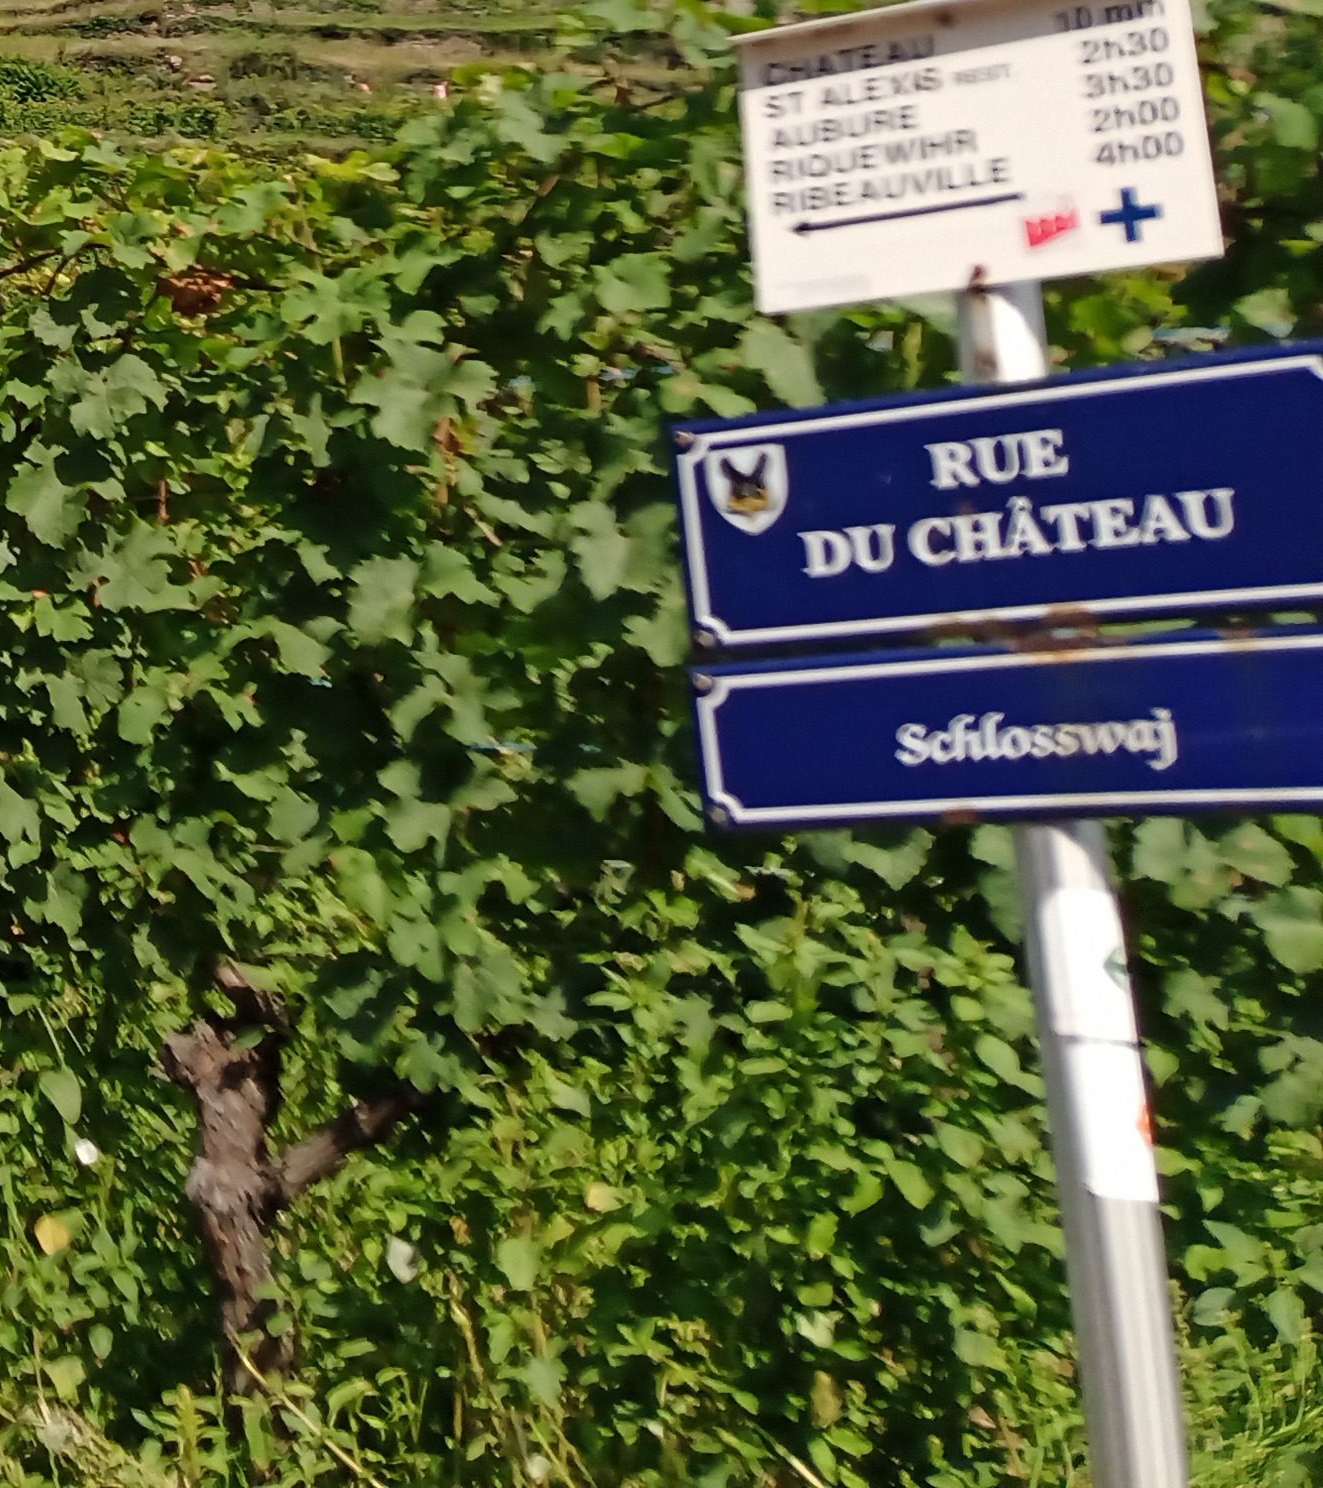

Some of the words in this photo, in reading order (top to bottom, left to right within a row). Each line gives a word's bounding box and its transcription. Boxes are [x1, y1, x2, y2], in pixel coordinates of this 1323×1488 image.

[1055, 9, 1093, 32] 10
[1079, 28, 1170, 64] 2h30
[764, 36, 936, 87] CHATEAU
[1083, 63, 1175, 99] 3h30
[763, 91, 804, 119] ST
[819, 67, 945, 107] ALEXIS
[1090, 96, 1182, 133] 2h00
[771, 105, 920, 151] AUBURE
[1095, 130, 1185, 167] 4h00
[769, 128, 979, 184] RIQUEWIHR
[771, 156, 1011, 216] RIBEAUVILLE
[923, 428, 1070, 491] RUE
[797, 523, 896, 579] DU
[907, 487, 1236, 568] CHÂTEAU
[894, 708, 1179, 772] Schlosswaj
